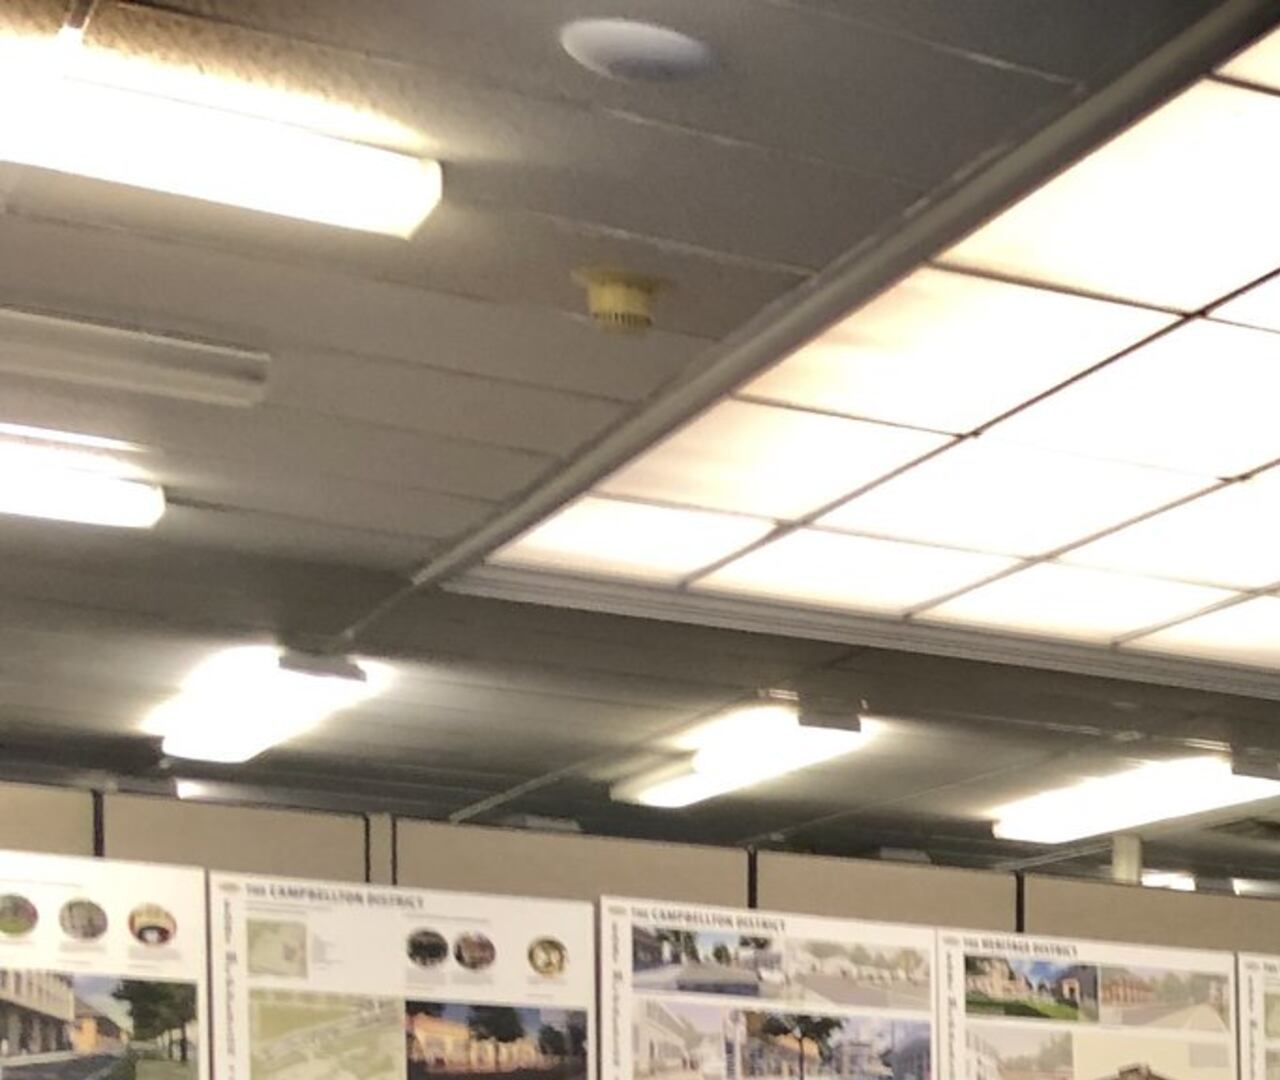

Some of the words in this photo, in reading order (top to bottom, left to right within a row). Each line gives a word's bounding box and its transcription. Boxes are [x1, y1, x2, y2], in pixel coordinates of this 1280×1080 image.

[367, 892, 424, 909] DISTRICT
[651, 908, 734, 928] CAMPBELLTON
[736, 915, 786, 932] DISTRICT
